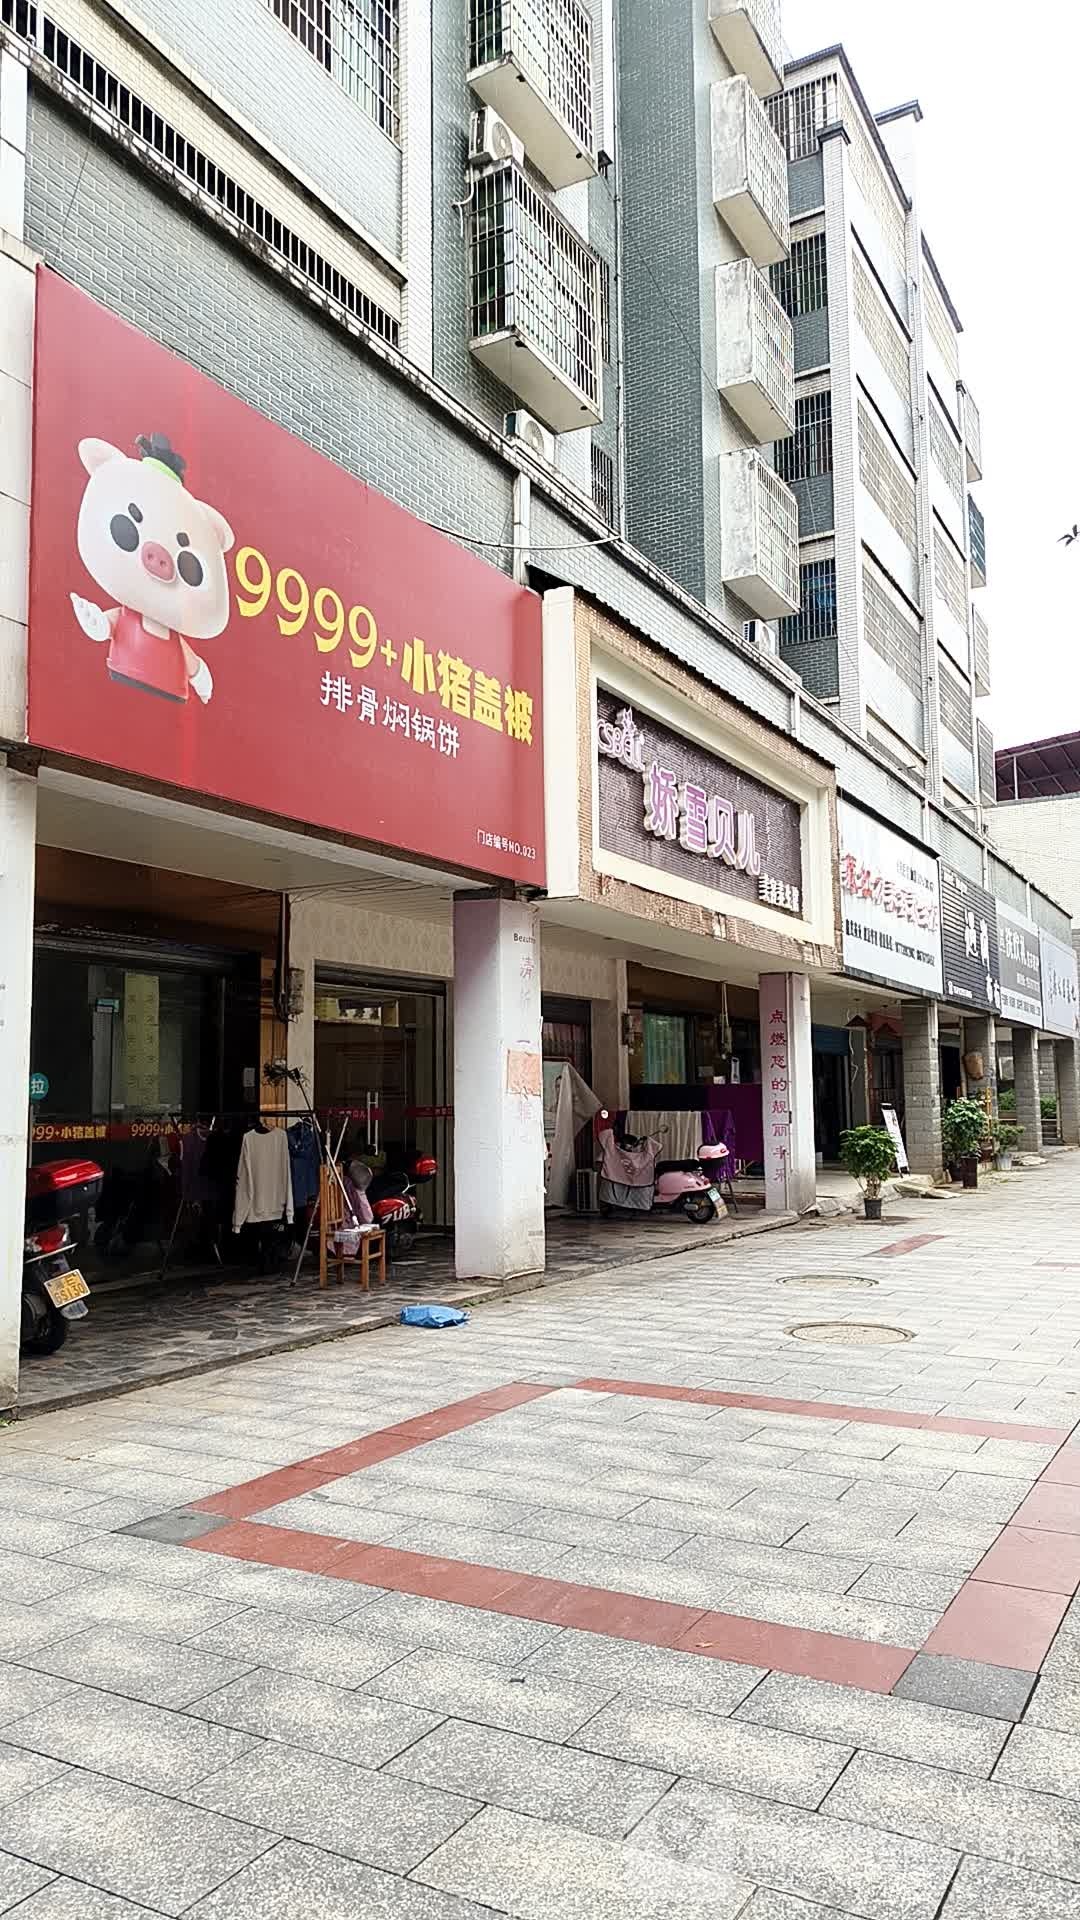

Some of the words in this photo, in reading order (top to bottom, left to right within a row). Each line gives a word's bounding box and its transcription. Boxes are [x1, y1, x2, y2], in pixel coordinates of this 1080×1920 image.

[320, 670, 461, 758] 排骨焖锅饼
[645, 760, 761, 876] 娇雪贝儿
[31, 1078, 45, 1094] 拉
